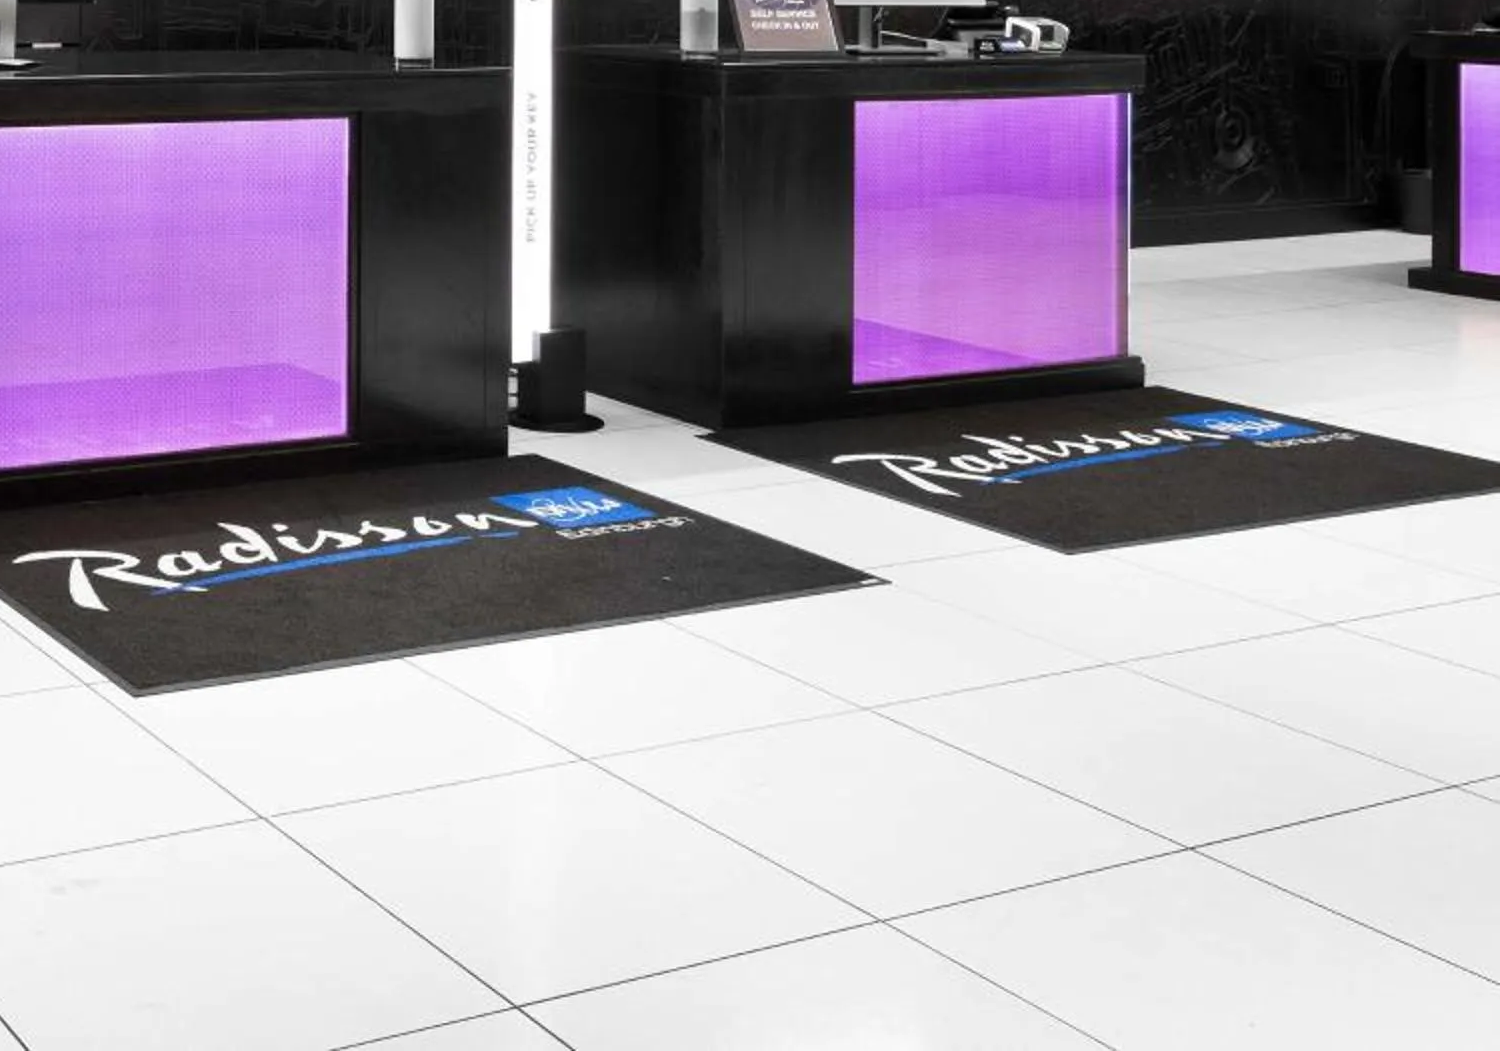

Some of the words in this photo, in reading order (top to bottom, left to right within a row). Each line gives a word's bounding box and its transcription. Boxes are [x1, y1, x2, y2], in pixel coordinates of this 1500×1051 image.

[526, 91, 538, 125] KEY
[526, 127, 538, 175] YOUR
[525, 179, 538, 201] UP
[525, 206, 537, 243] PICK
[831, 428, 1231, 497] Radisson
[12, 512, 539, 612] Radisson
